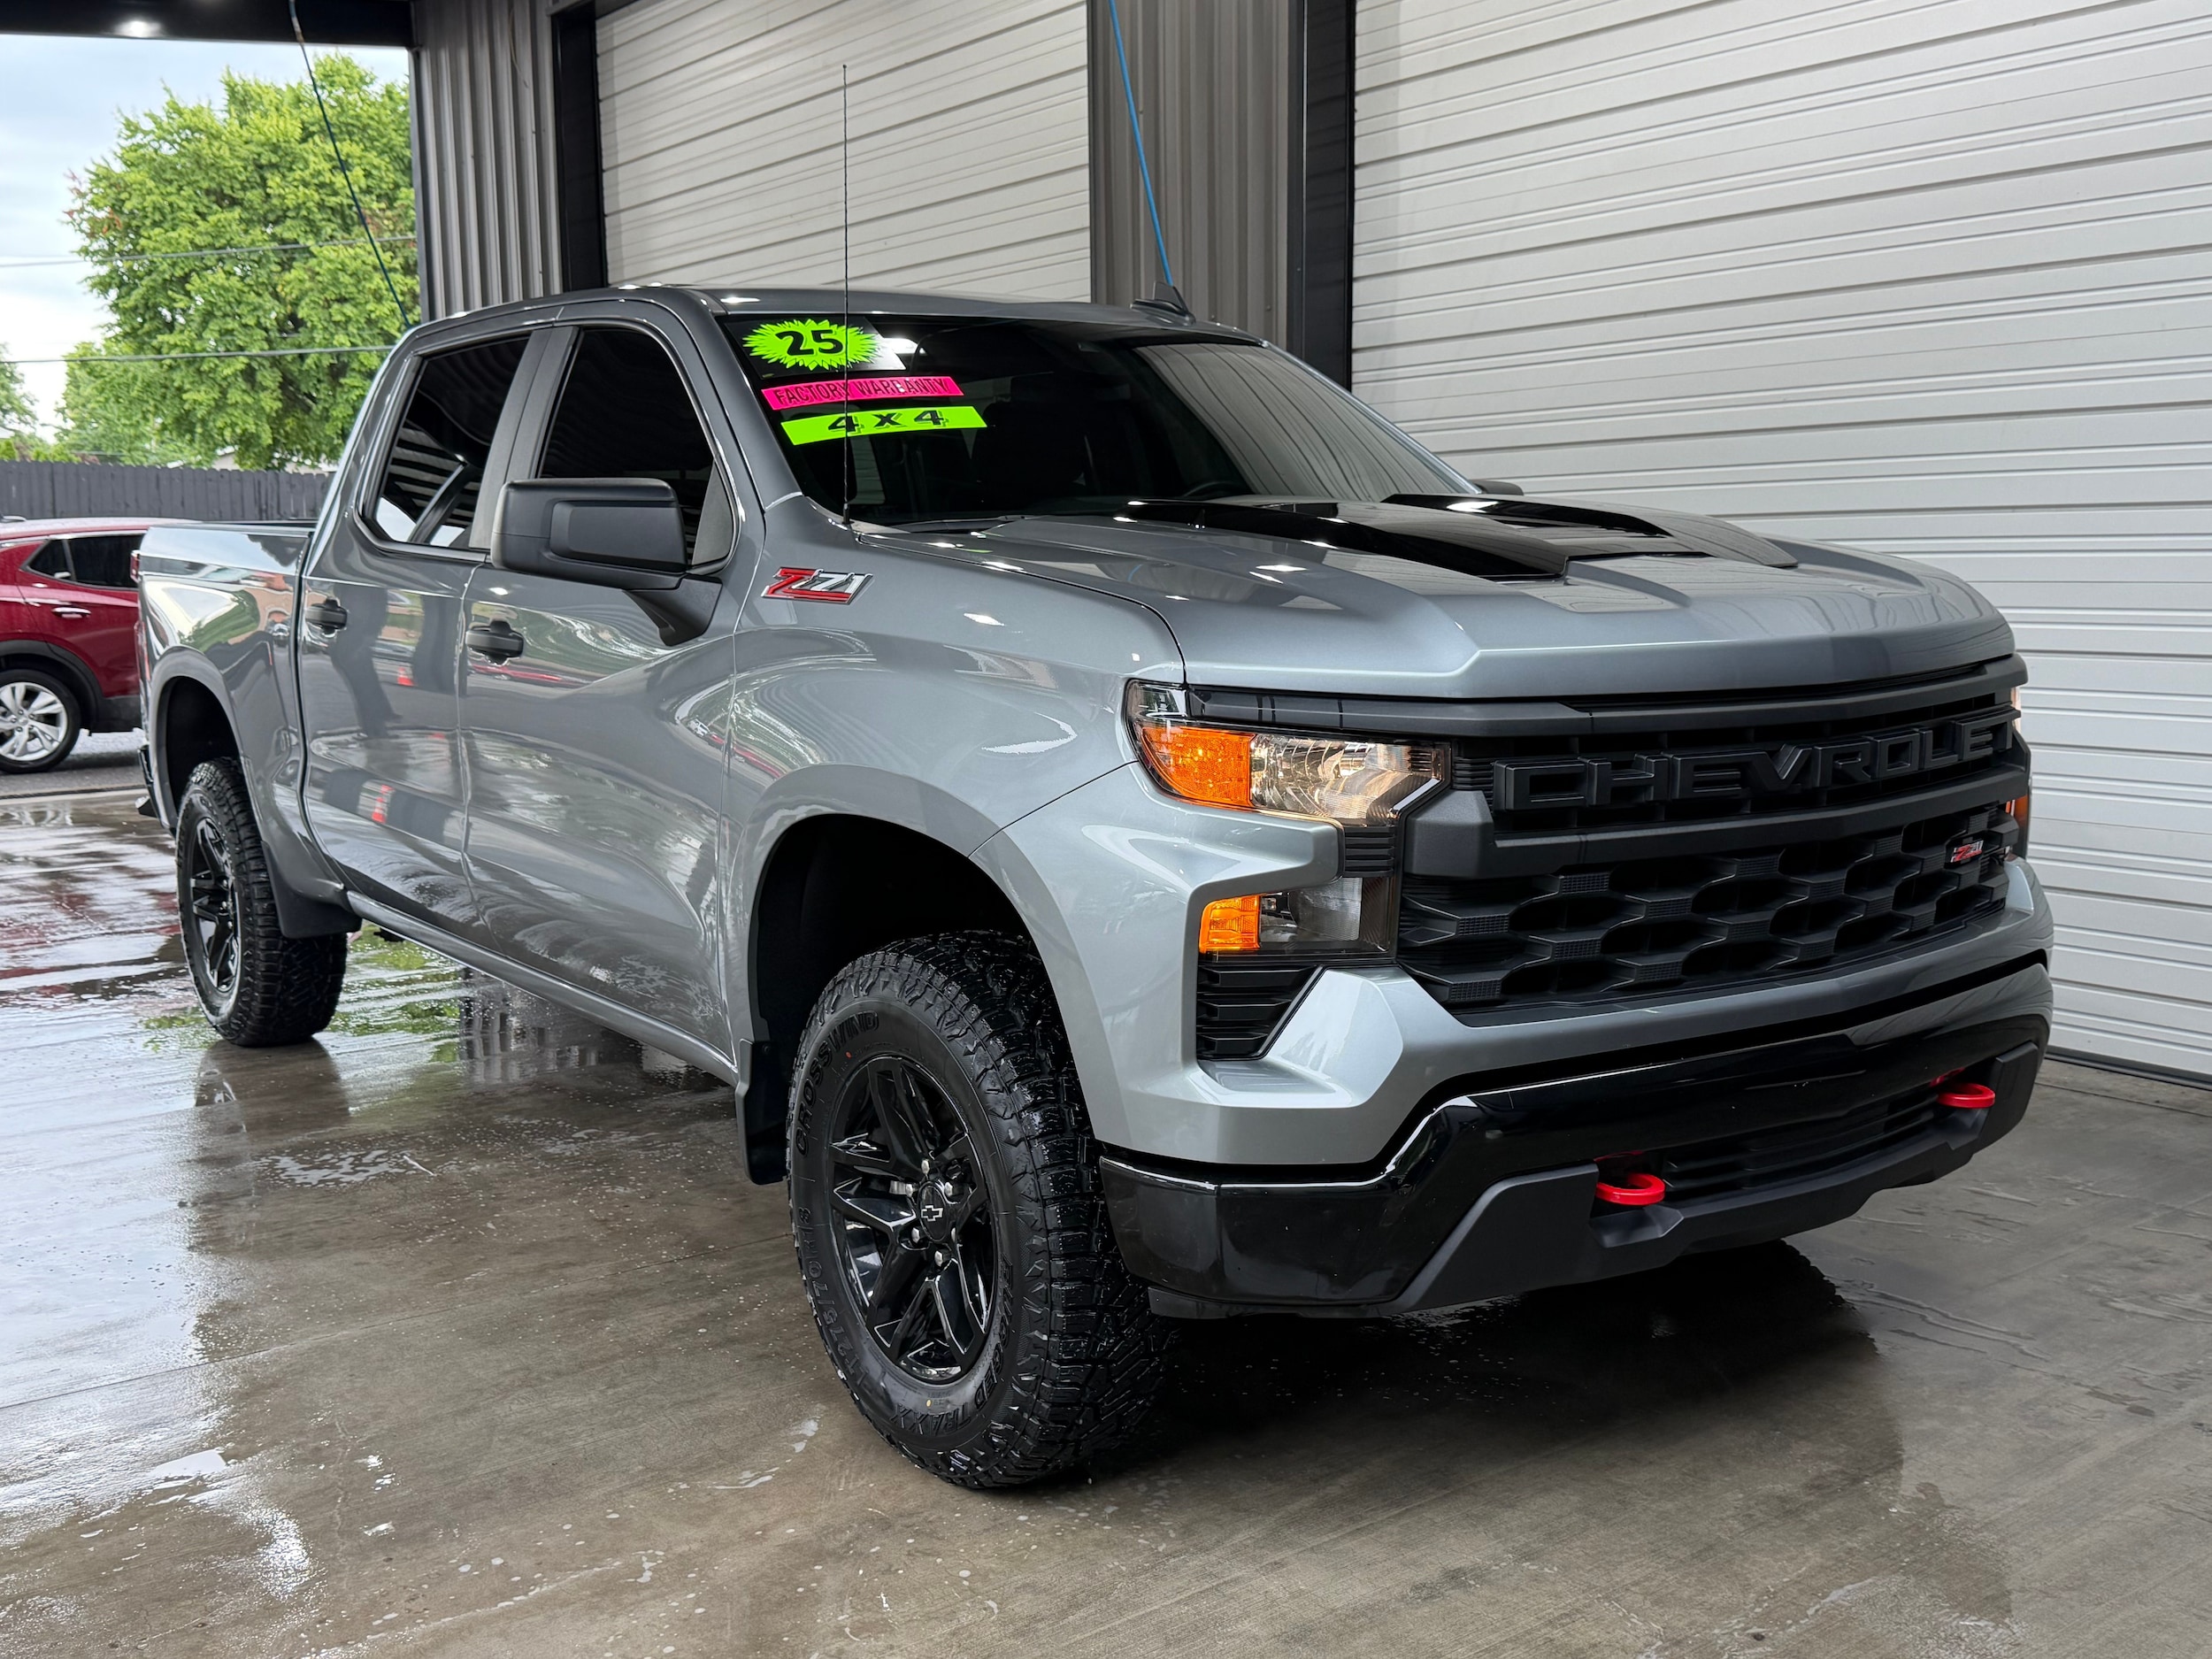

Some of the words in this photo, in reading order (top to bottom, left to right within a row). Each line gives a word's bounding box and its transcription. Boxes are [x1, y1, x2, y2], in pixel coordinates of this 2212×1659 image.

[775, 328, 844, 356] 25
[773, 381, 850, 405] FACTORY
[854, 379, 949, 396] WARRANTY
[761, 566, 873, 605] Z71
[1493, 706, 2020, 811] CHEVROLET
[795, 1010, 879, 1157] CROSSWIND
